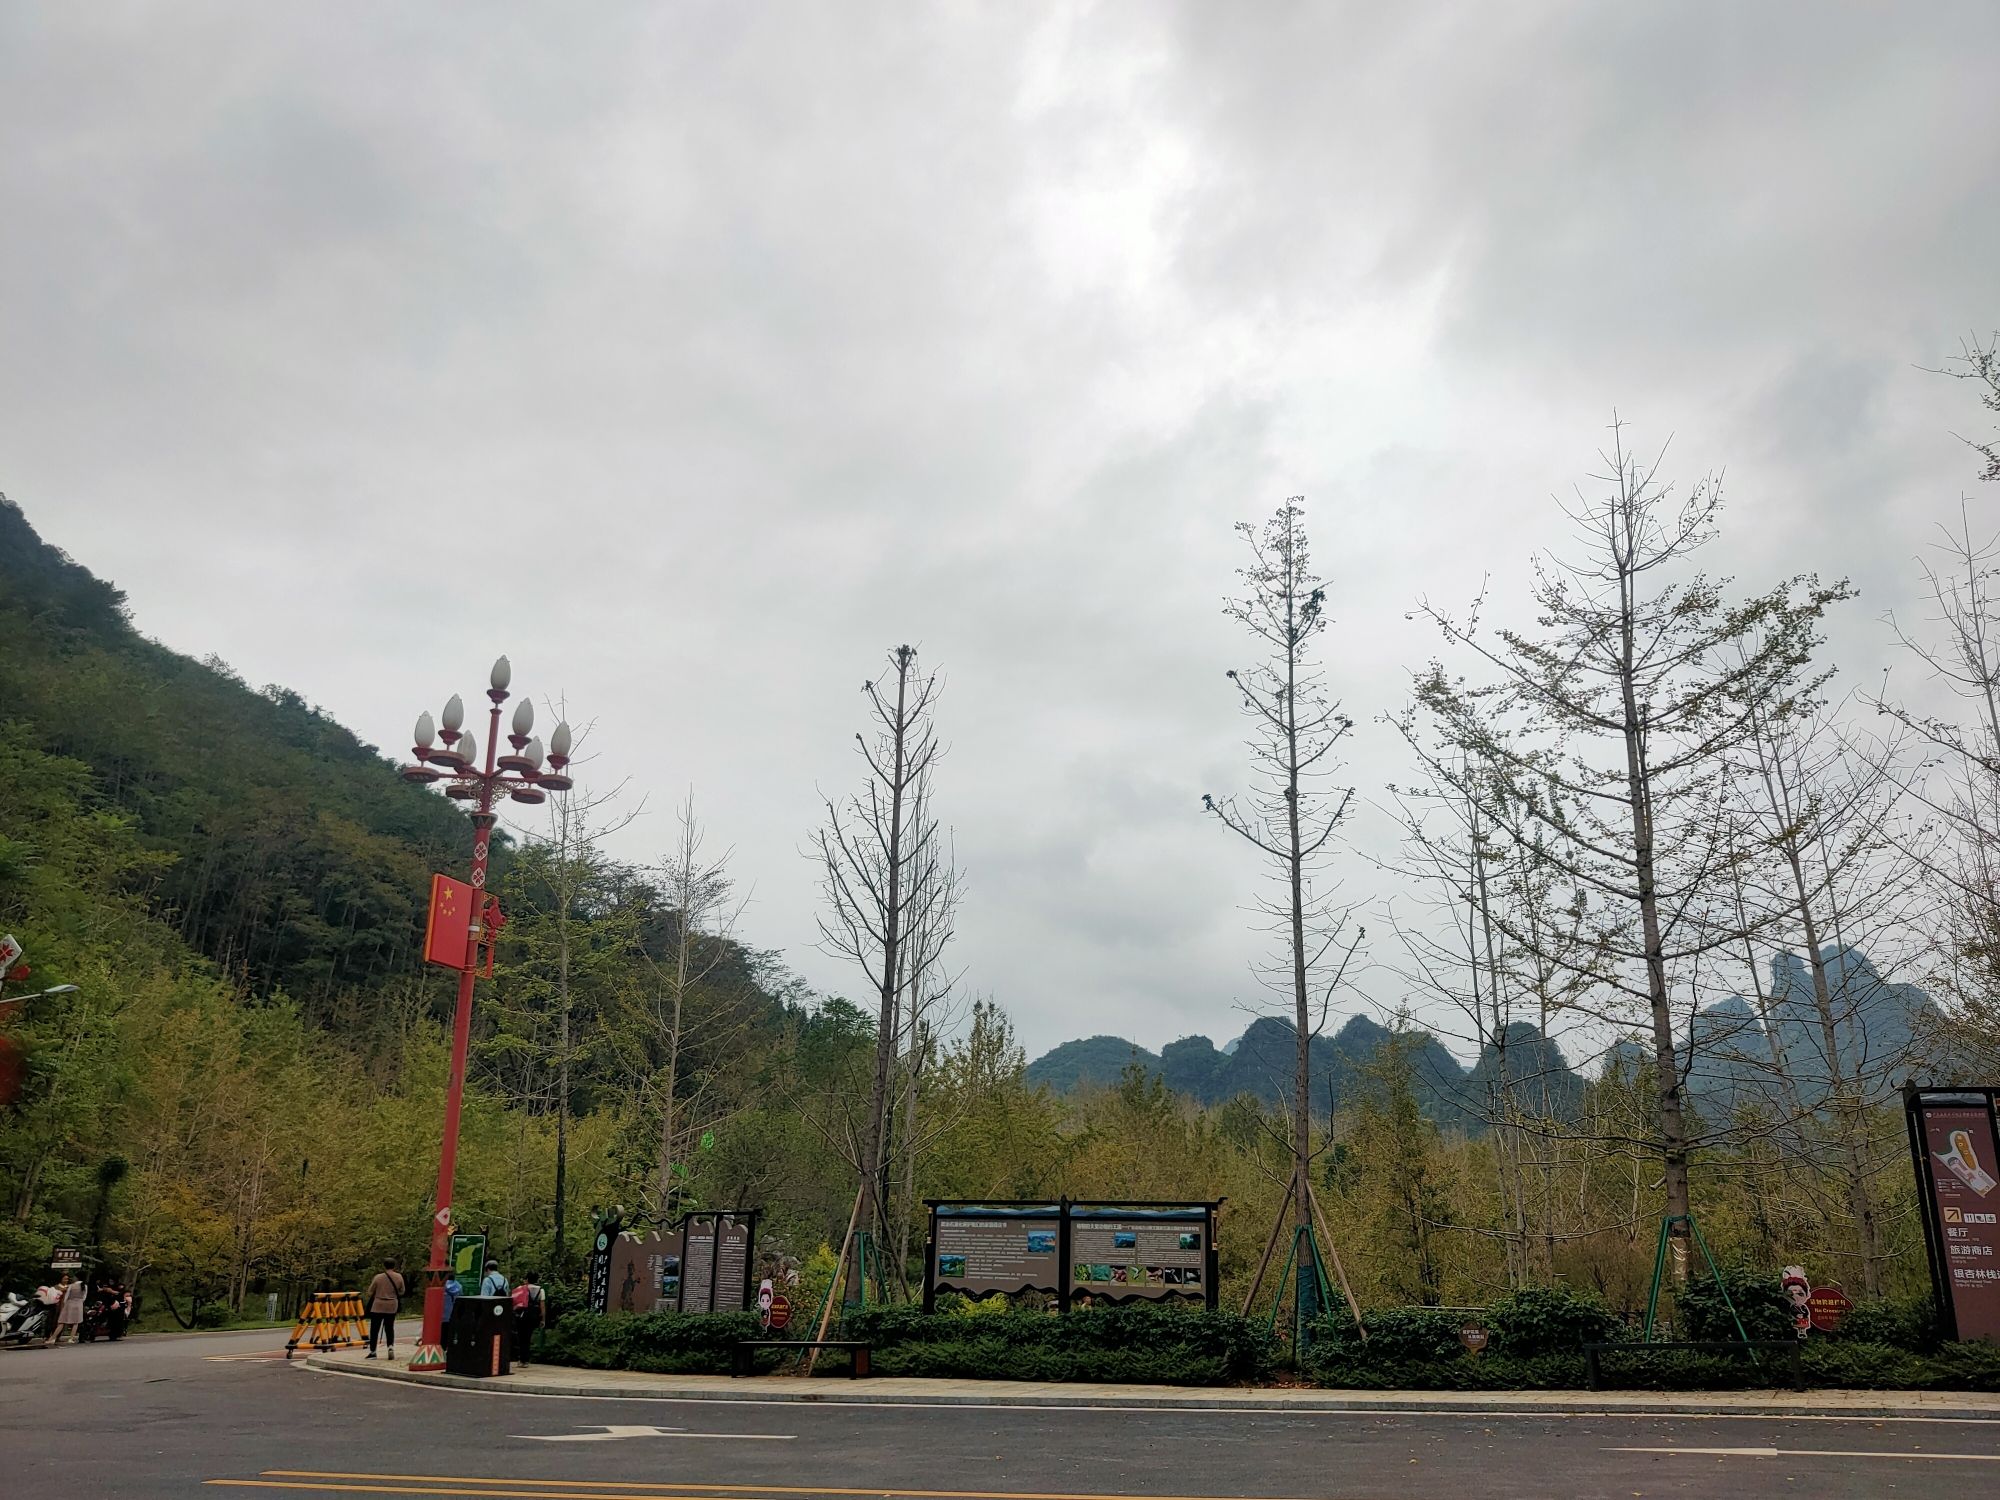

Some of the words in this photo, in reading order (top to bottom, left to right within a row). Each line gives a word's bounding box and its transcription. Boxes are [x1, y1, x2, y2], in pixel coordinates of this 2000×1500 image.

[1947, 1227, 1968, 1237] 餐厅
[1950, 1245, 1993, 1256] 旅游商店
